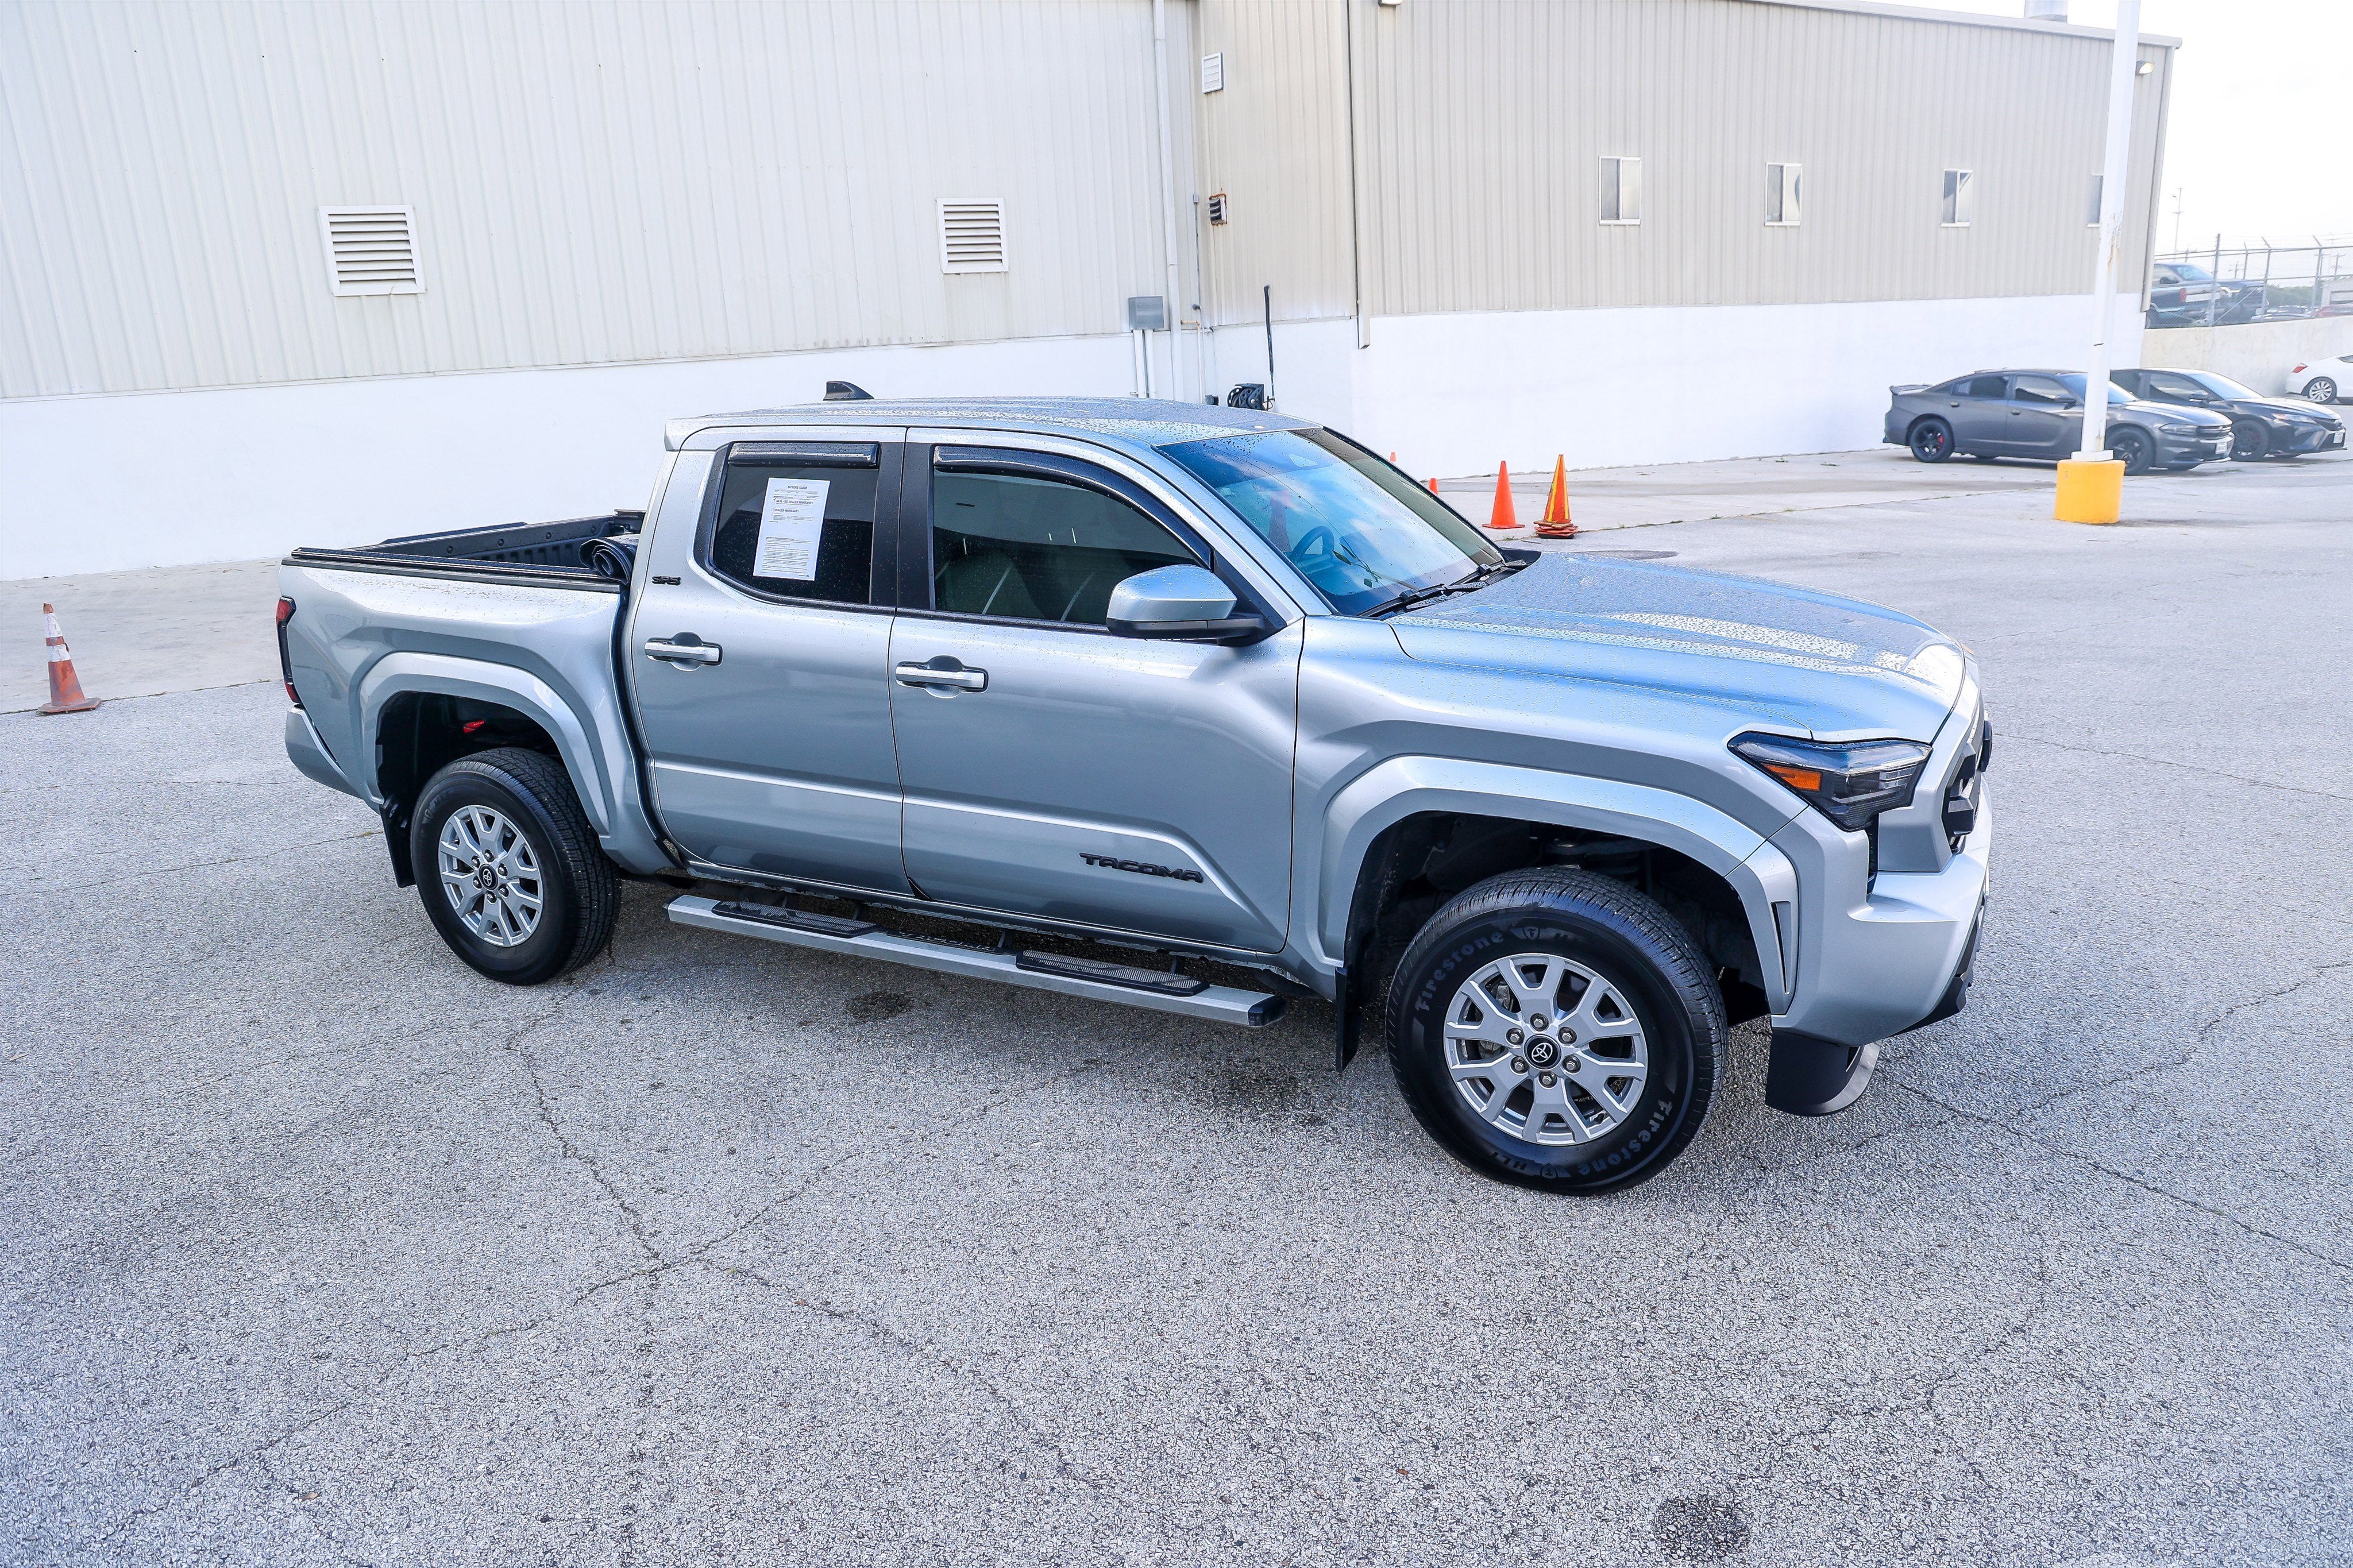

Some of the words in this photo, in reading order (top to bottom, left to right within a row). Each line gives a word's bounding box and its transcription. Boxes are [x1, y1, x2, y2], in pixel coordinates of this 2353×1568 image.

[1078, 852, 1205, 884] TACOMA
[1415, 932, 1505, 1011] Firestone
[1577, 1099, 1673, 1176] Firestone
